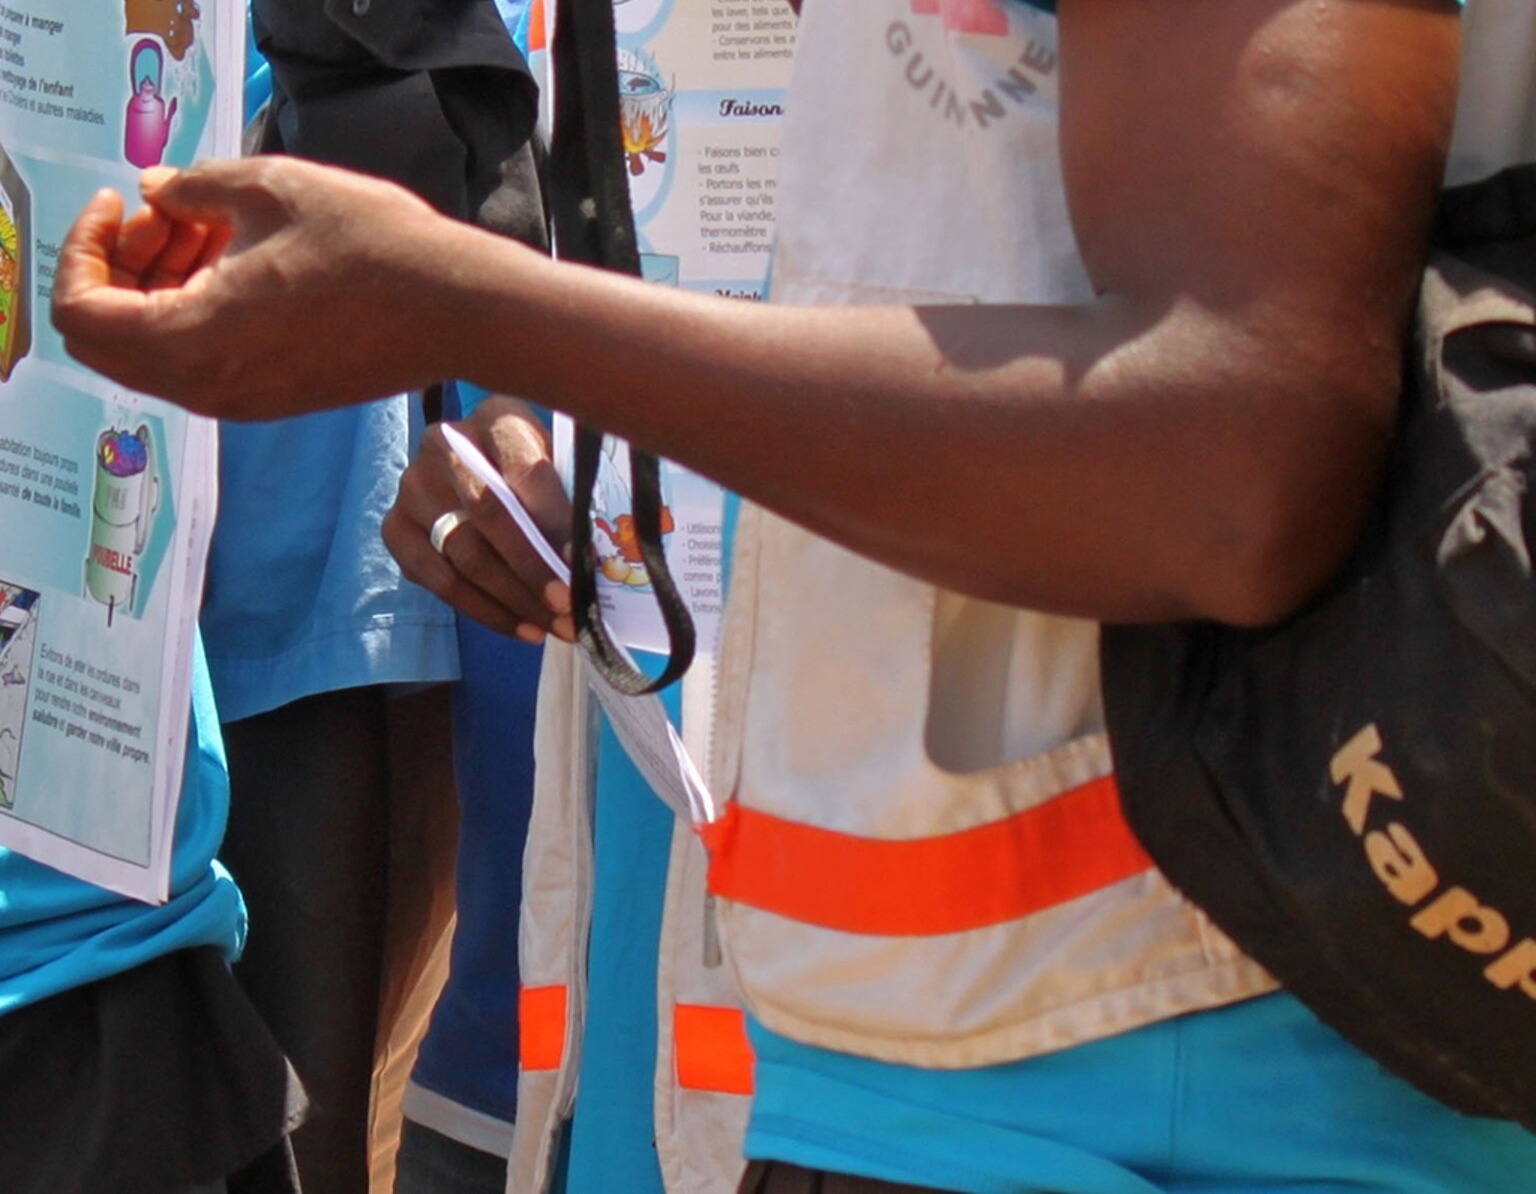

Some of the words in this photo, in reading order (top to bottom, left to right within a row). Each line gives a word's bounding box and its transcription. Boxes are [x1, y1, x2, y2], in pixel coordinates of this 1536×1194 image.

[711, 7, 724, 17] les
[751, 6, 768, 16] tels
[770, 6, 789, 18] que
[31, 17, 64, 35] manger
[711, 22, 732, 34] pour
[734, 21, 750, 31] des
[752, 20, 793, 31] aliments
[719, 35, 771, 46] Conservons
[773, 34, 787, 44] les
[712, 50, 736, 61] entre
[738, 49, 751, 59] les
[753, 48, 793, 60] aliments
[38, 78, 74, 98] l'enfant
[719, 98, 784, 118] Faison
[704, 146, 741, 158] Faisons
[743, 146, 767, 157] bien
[697, 163, 712, 174] les
[706, 178, 743, 190] Portons
[745, 177, 762, 190] les
[699, 194, 742, 207] s'assurer
[745, 193, 774, 207] qu'ils
[700, 210, 723, 222] Pour
[725, 209, 734, 222] la
[736, 210, 777, 223] viande,
[700, 225, 767, 238] thermomètre
[21, 487, 32, 502] de
[683, 572, 713, 582] comme
